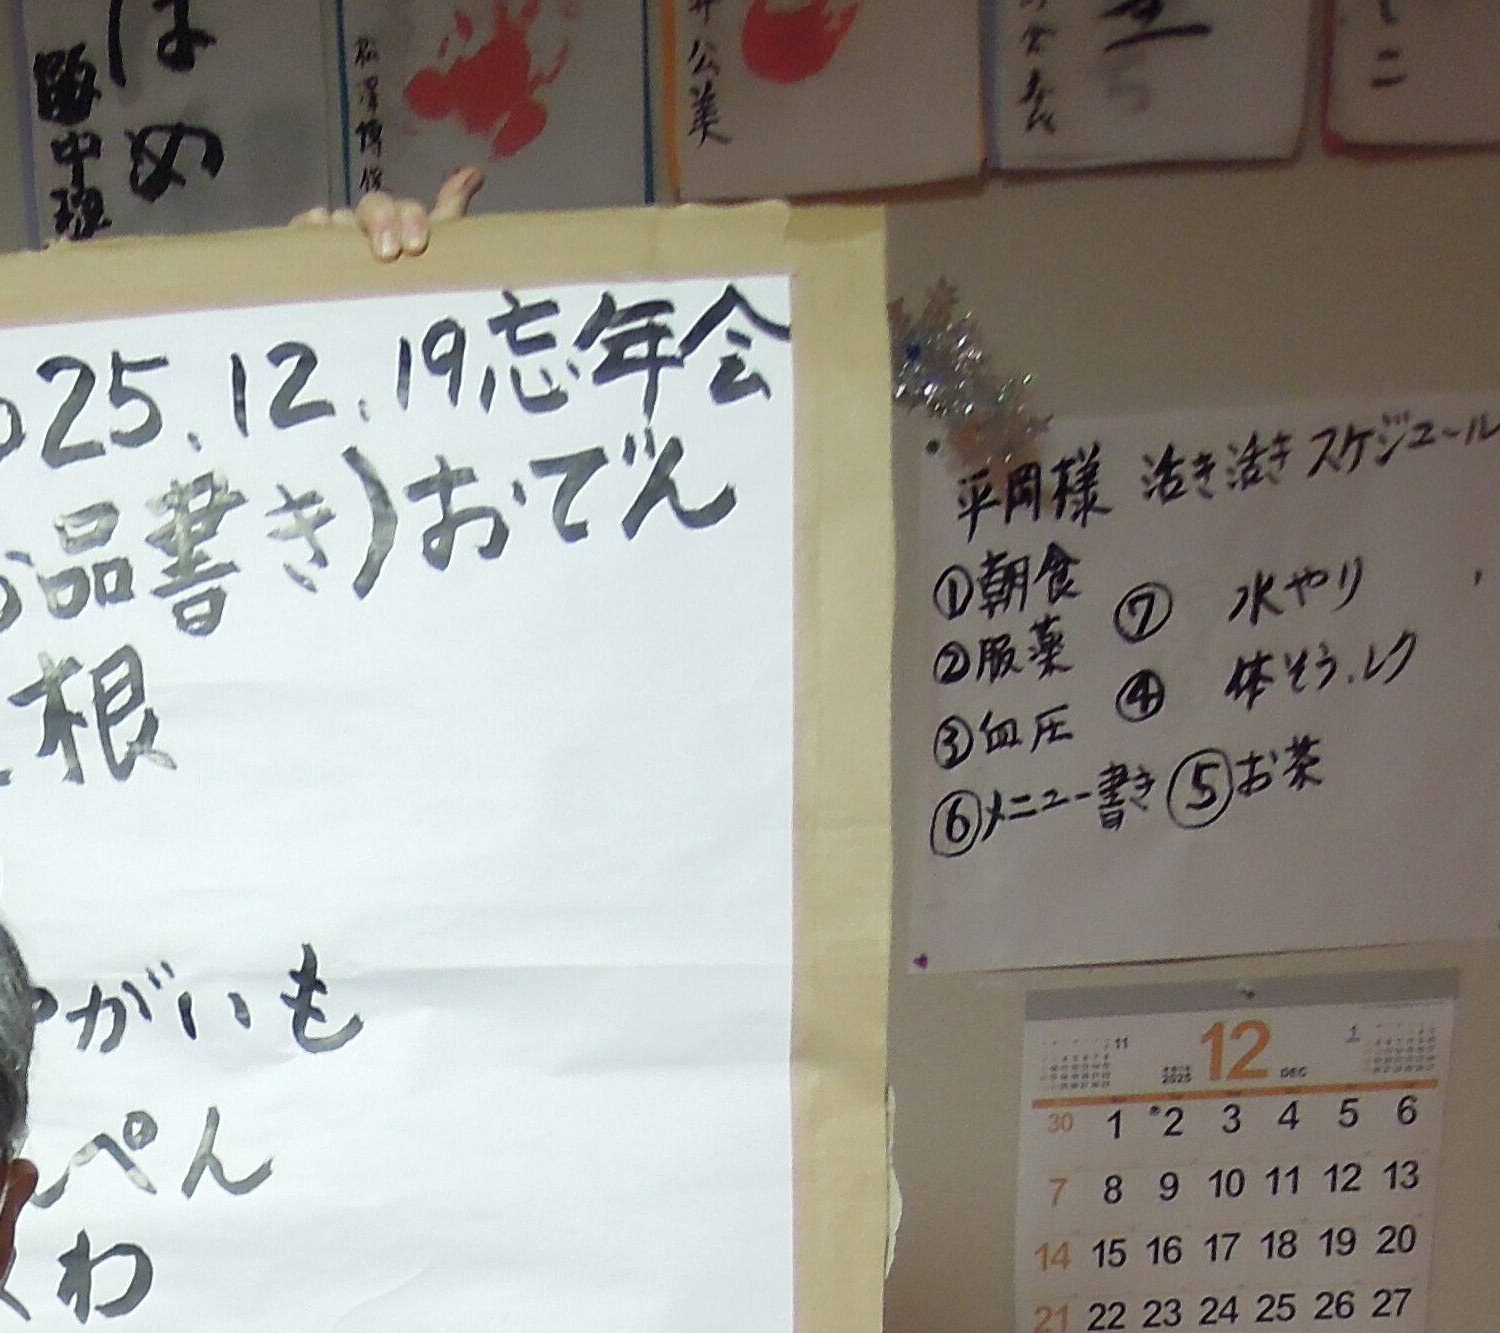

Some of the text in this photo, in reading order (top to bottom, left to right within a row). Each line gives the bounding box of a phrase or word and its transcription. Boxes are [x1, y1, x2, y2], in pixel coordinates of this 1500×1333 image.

[957, 441, 1113, 542] 平岡様
[1202, 1020, 1272, 1082] 12
[1047, 1095, 1418, 1140] 30 1 2 3 4 5 6
[1049, 1160, 1420, 1207] 7 8 9 10 11 12 13
[1034, 1223, 1417, 1272] 14 15 16 17 18 19 20
[1087, 1301, 1127, 1332] 22
[1141, 1298, 1183, 1330] 23
[1199, 1295, 1239, 1327] 24
[1255, 1292, 1297, 1324] 25
[1313, 1290, 1355, 1322] 26
[1371, 1287, 1413, 1320] 27
